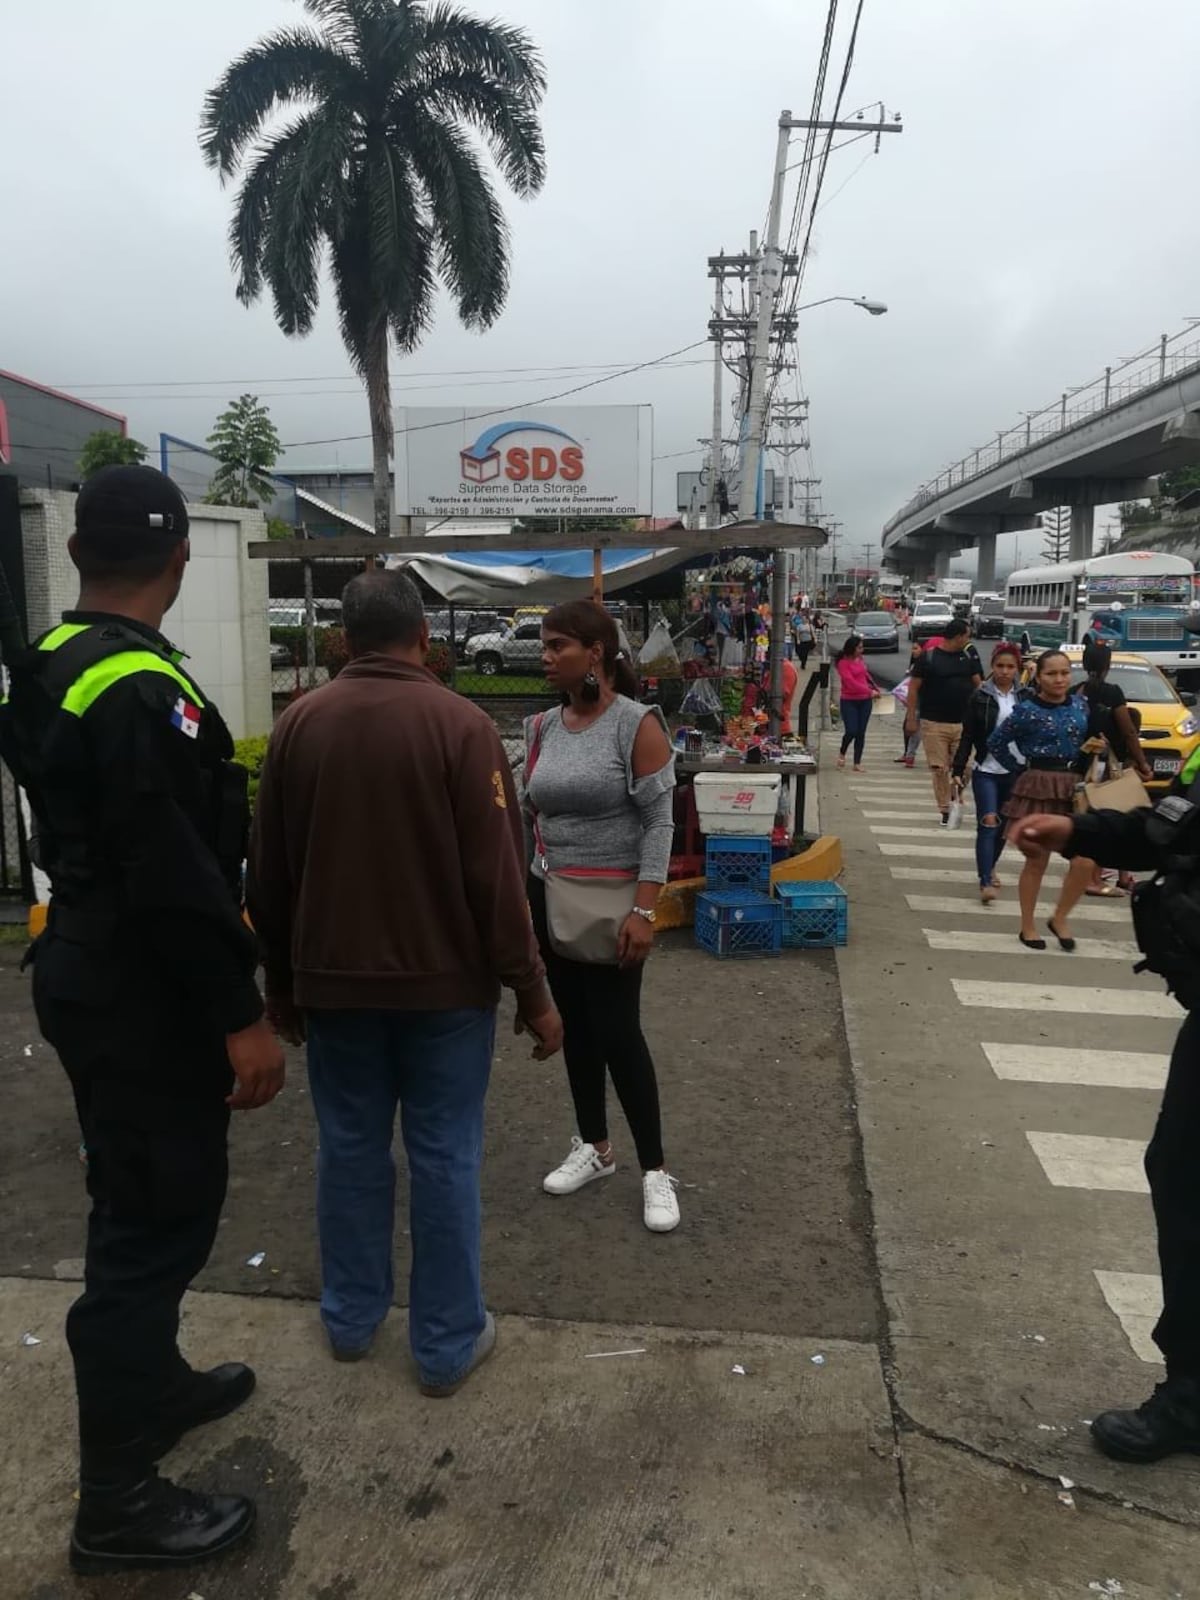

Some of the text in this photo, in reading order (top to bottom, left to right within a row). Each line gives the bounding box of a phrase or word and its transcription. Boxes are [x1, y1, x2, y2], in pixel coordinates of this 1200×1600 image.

[505, 447, 583, 481] SDS
[459, 483, 587, 496] Supreme Data Storage
[535, 506, 636, 515] www.sdspanama.com
